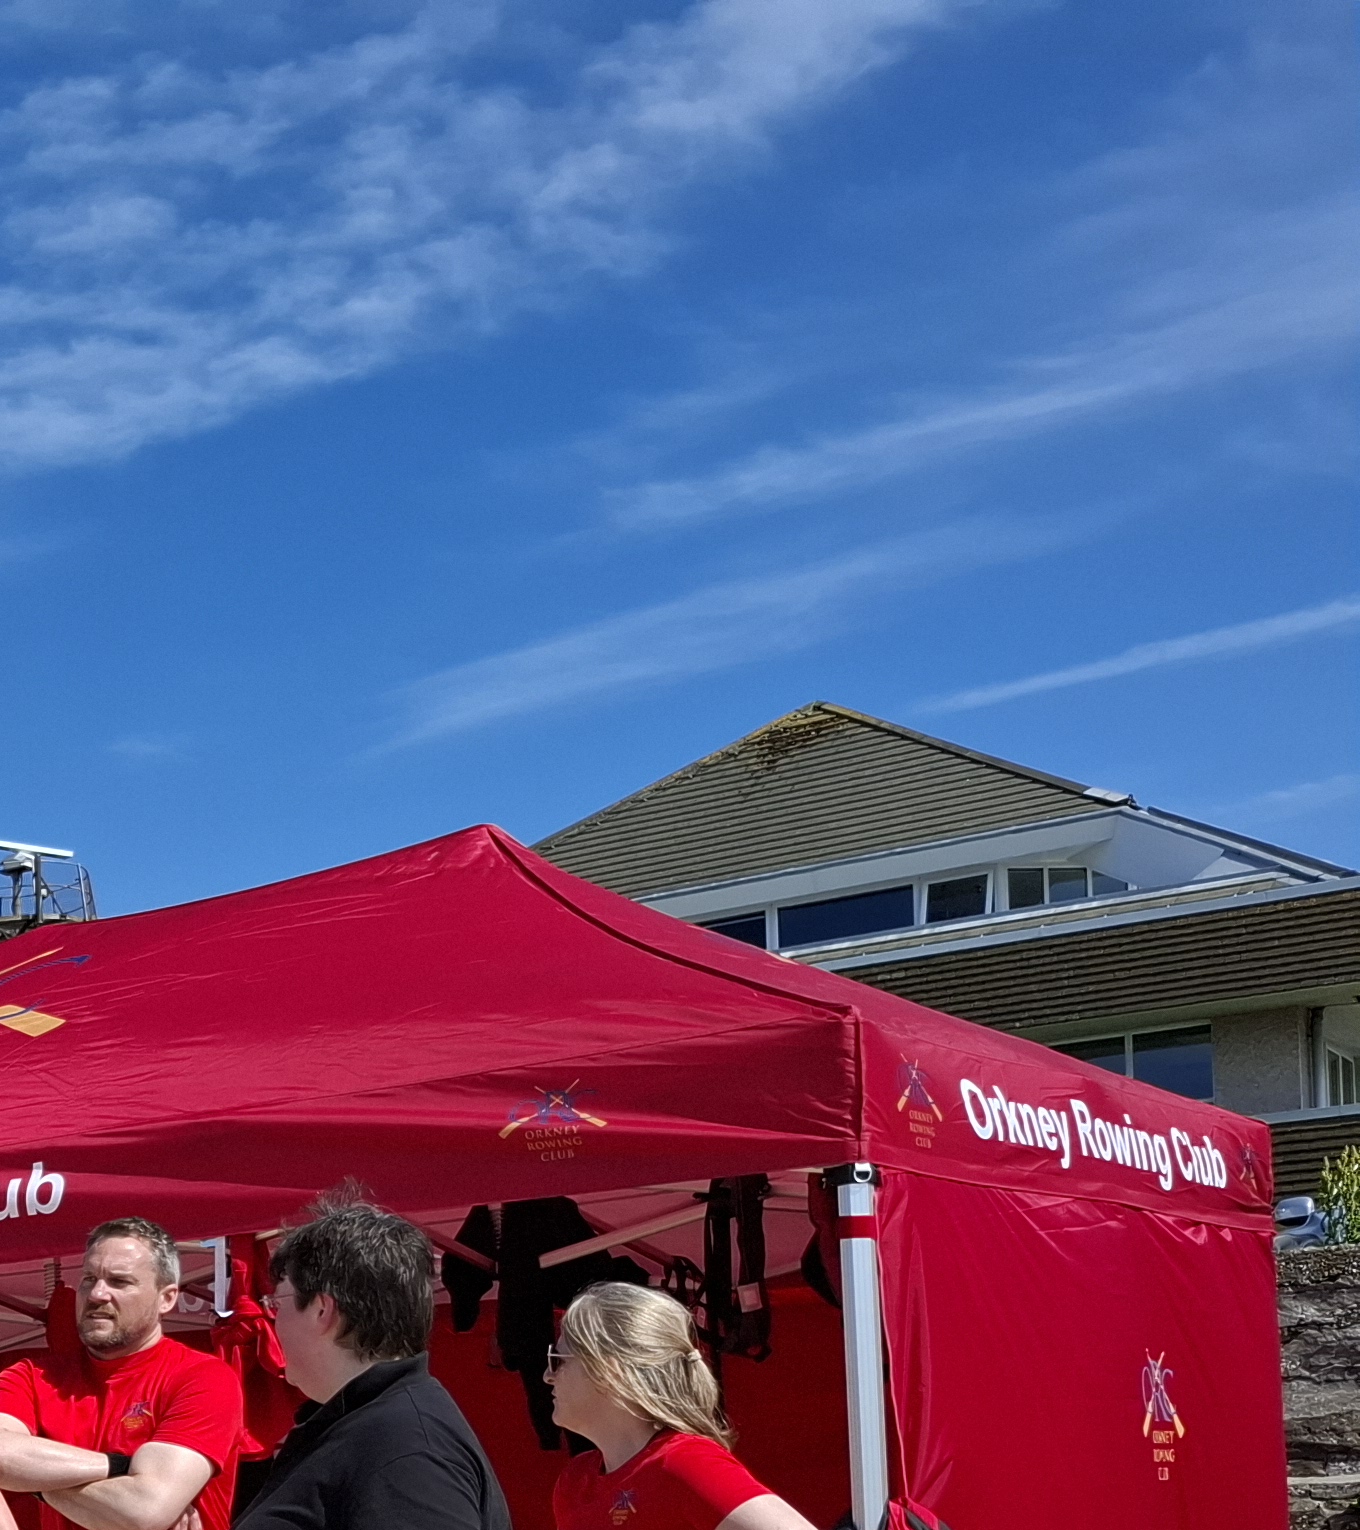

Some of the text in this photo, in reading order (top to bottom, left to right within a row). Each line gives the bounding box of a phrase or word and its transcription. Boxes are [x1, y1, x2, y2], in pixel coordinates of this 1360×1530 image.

[524, 1125, 580, 1140] ORKNEY
[959, 1078, 1227, 1191] Orkney Rowing Club
[526, 1136, 583, 1151] ROWING
[540, 1149, 575, 1162] CLUB
